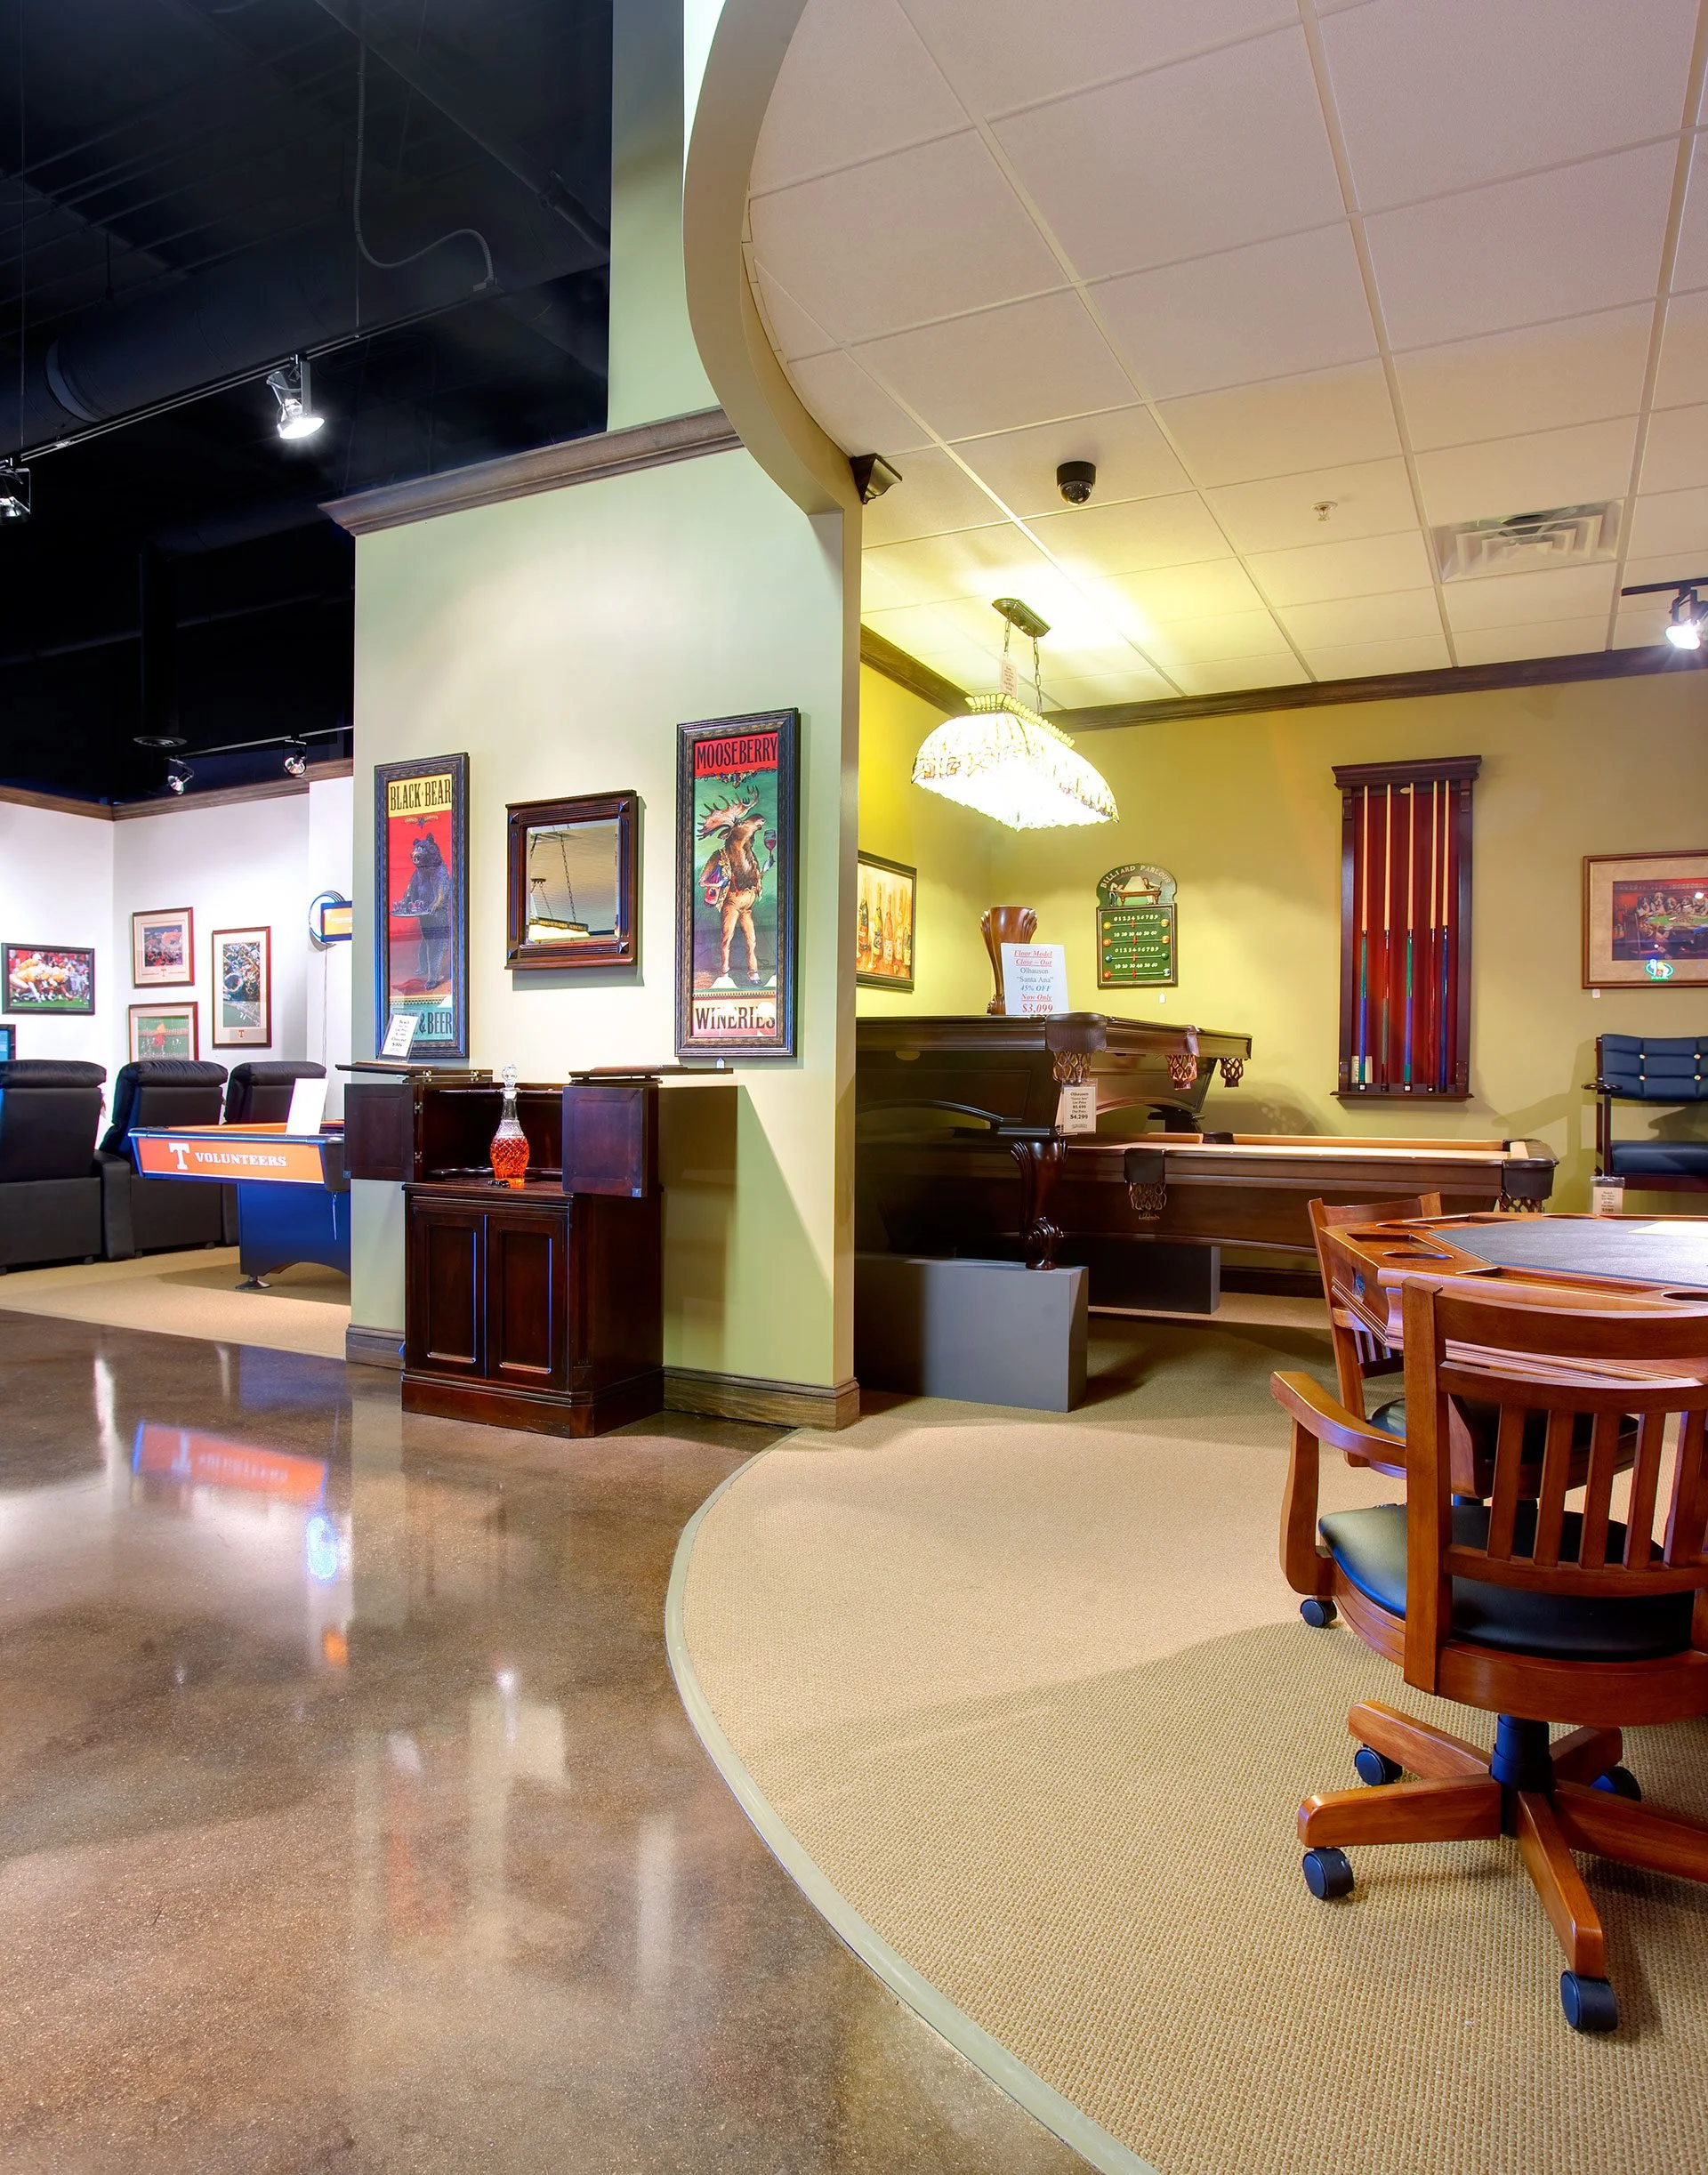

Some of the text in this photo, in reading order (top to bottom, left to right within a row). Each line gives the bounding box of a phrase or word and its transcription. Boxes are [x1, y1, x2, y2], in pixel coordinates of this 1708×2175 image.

[697, 737, 777, 769] MOOSEBERRY
[391, 779, 452, 811] BLACK BEAR
[1100, 865, 1172, 889] BILLIARD PARLOUR
[1022, 1003, 1053, 1013] $3,099
[1037, 994, 1052, 1002] Only
[238, 1029, 245, 1037] T
[419, 1012, 426, 1035] &
[428, 1011, 452, 1035] BEER
[168, 1142, 287, 1171] T VOLUNTEERS
